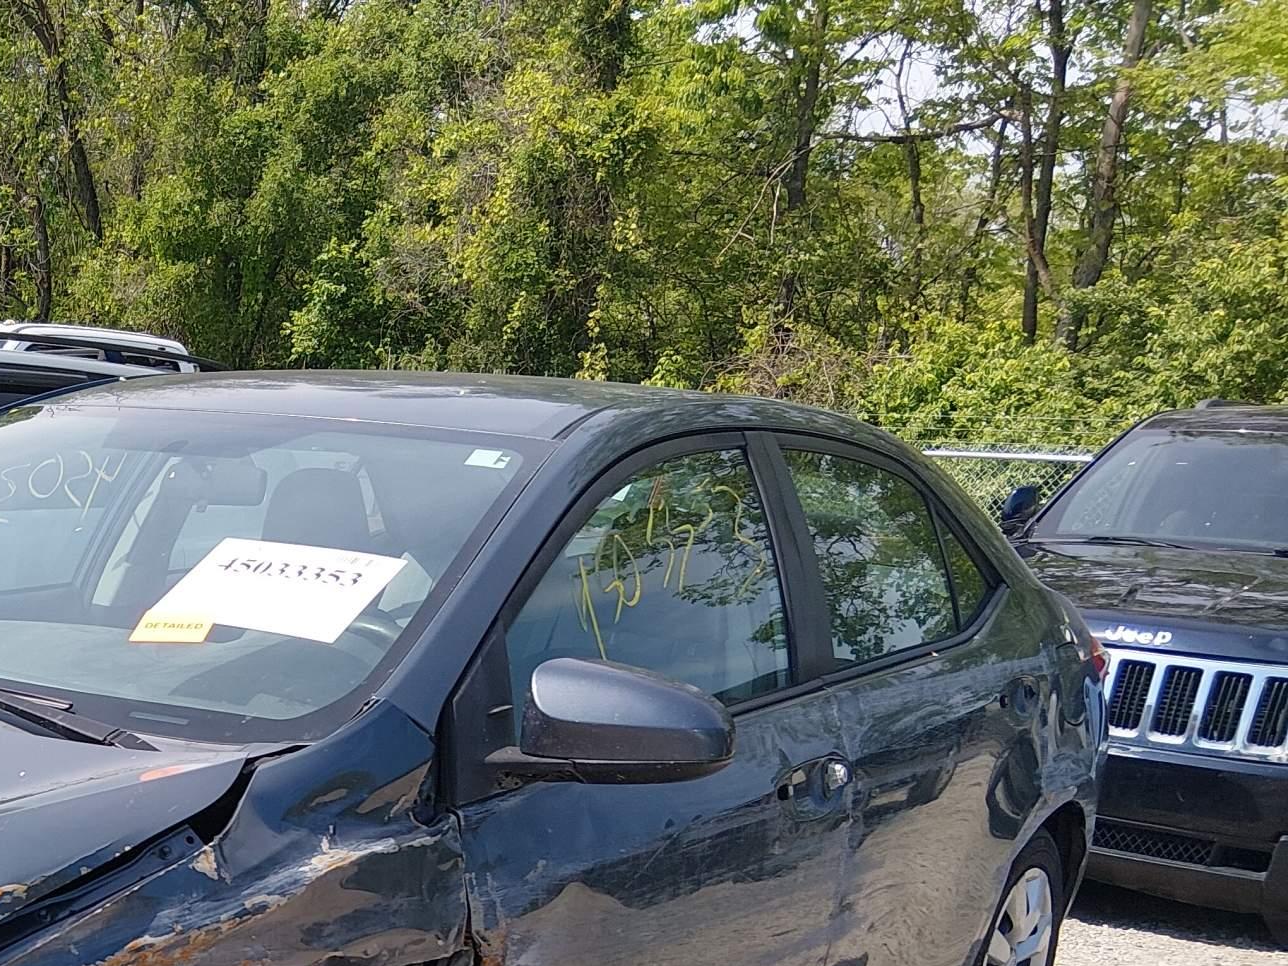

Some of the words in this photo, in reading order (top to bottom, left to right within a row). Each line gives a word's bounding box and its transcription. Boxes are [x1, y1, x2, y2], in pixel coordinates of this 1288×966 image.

[218, 557, 363, 587] 45033353
[144, 621, 204, 630] DETAILED
[1105, 625, 1172, 646] Jeep
